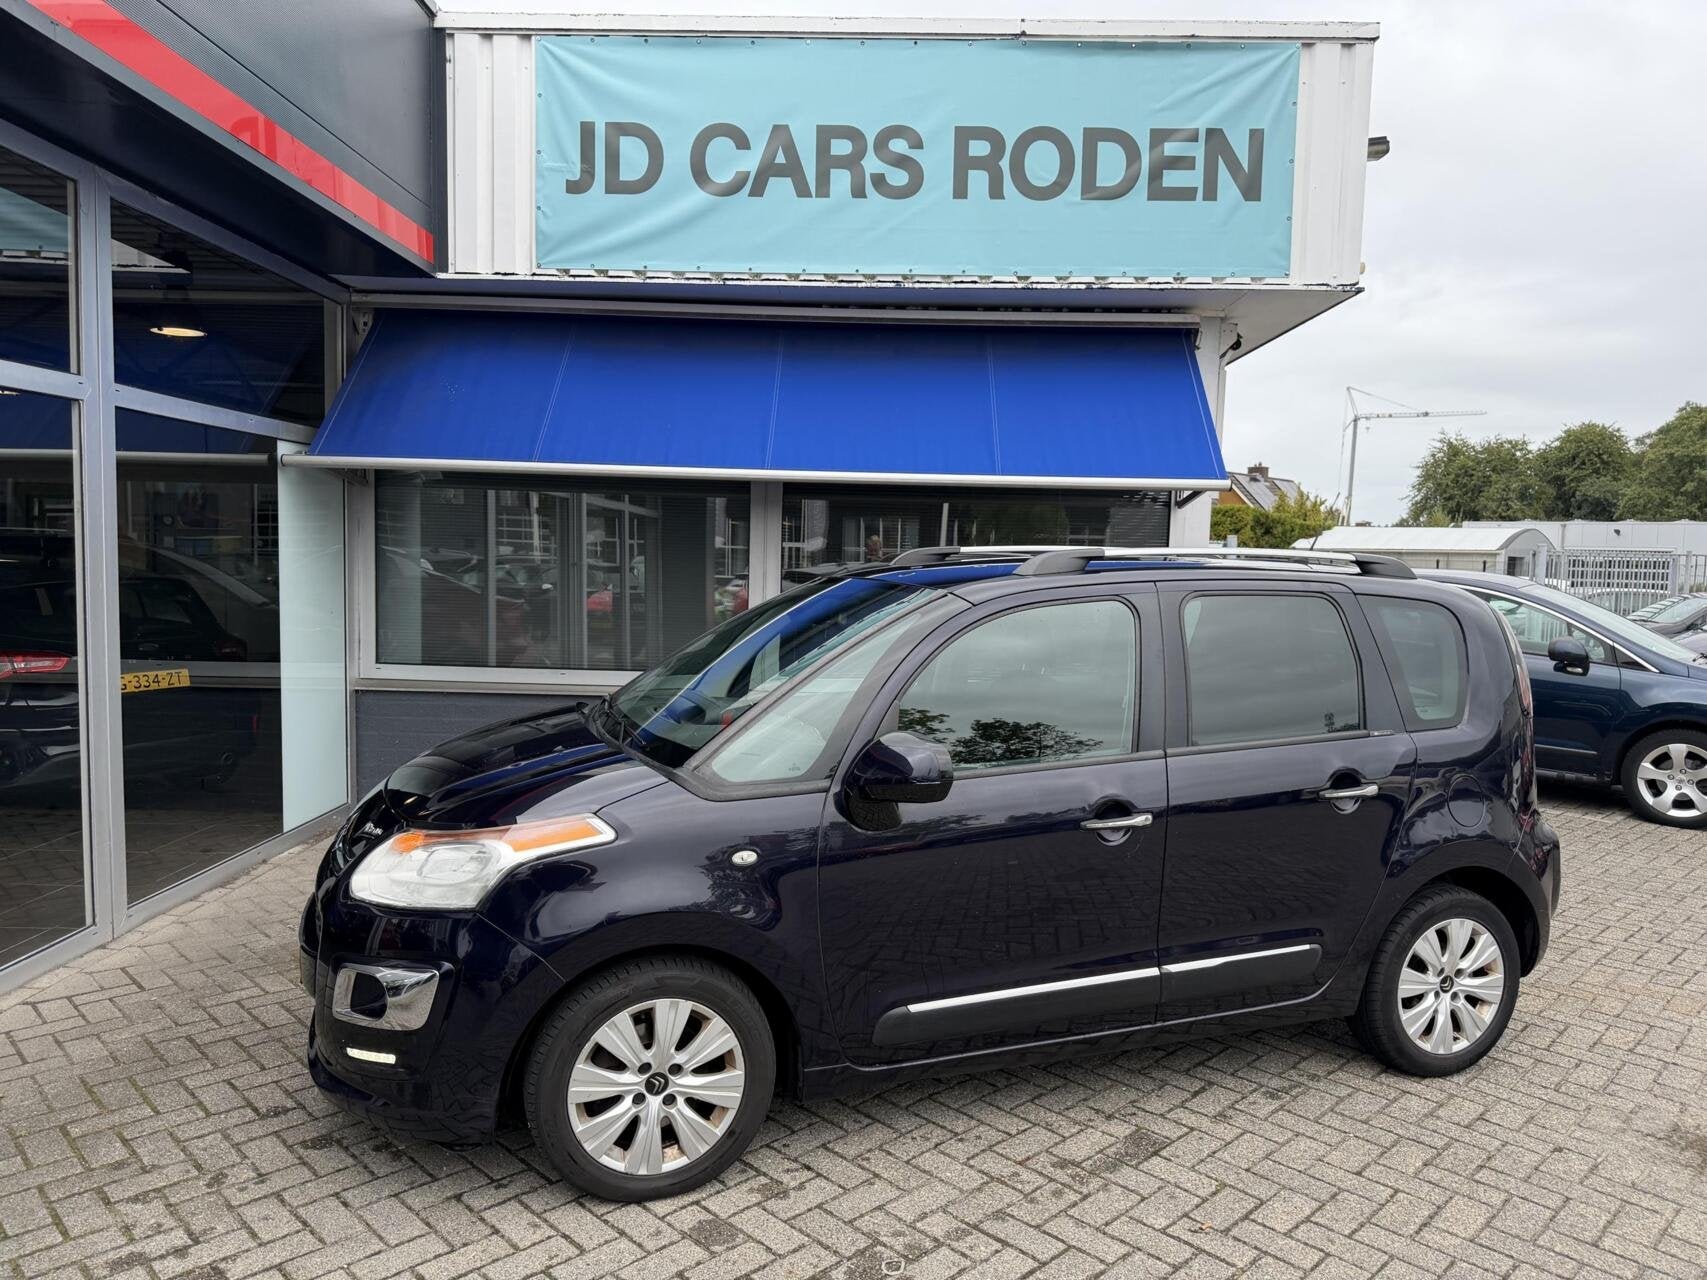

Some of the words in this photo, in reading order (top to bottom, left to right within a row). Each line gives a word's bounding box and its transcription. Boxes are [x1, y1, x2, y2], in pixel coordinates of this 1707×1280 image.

[565, 120, 665, 195] JD
[689, 121, 925, 200] CARS
[952, 124, 1265, 202] RODEN
